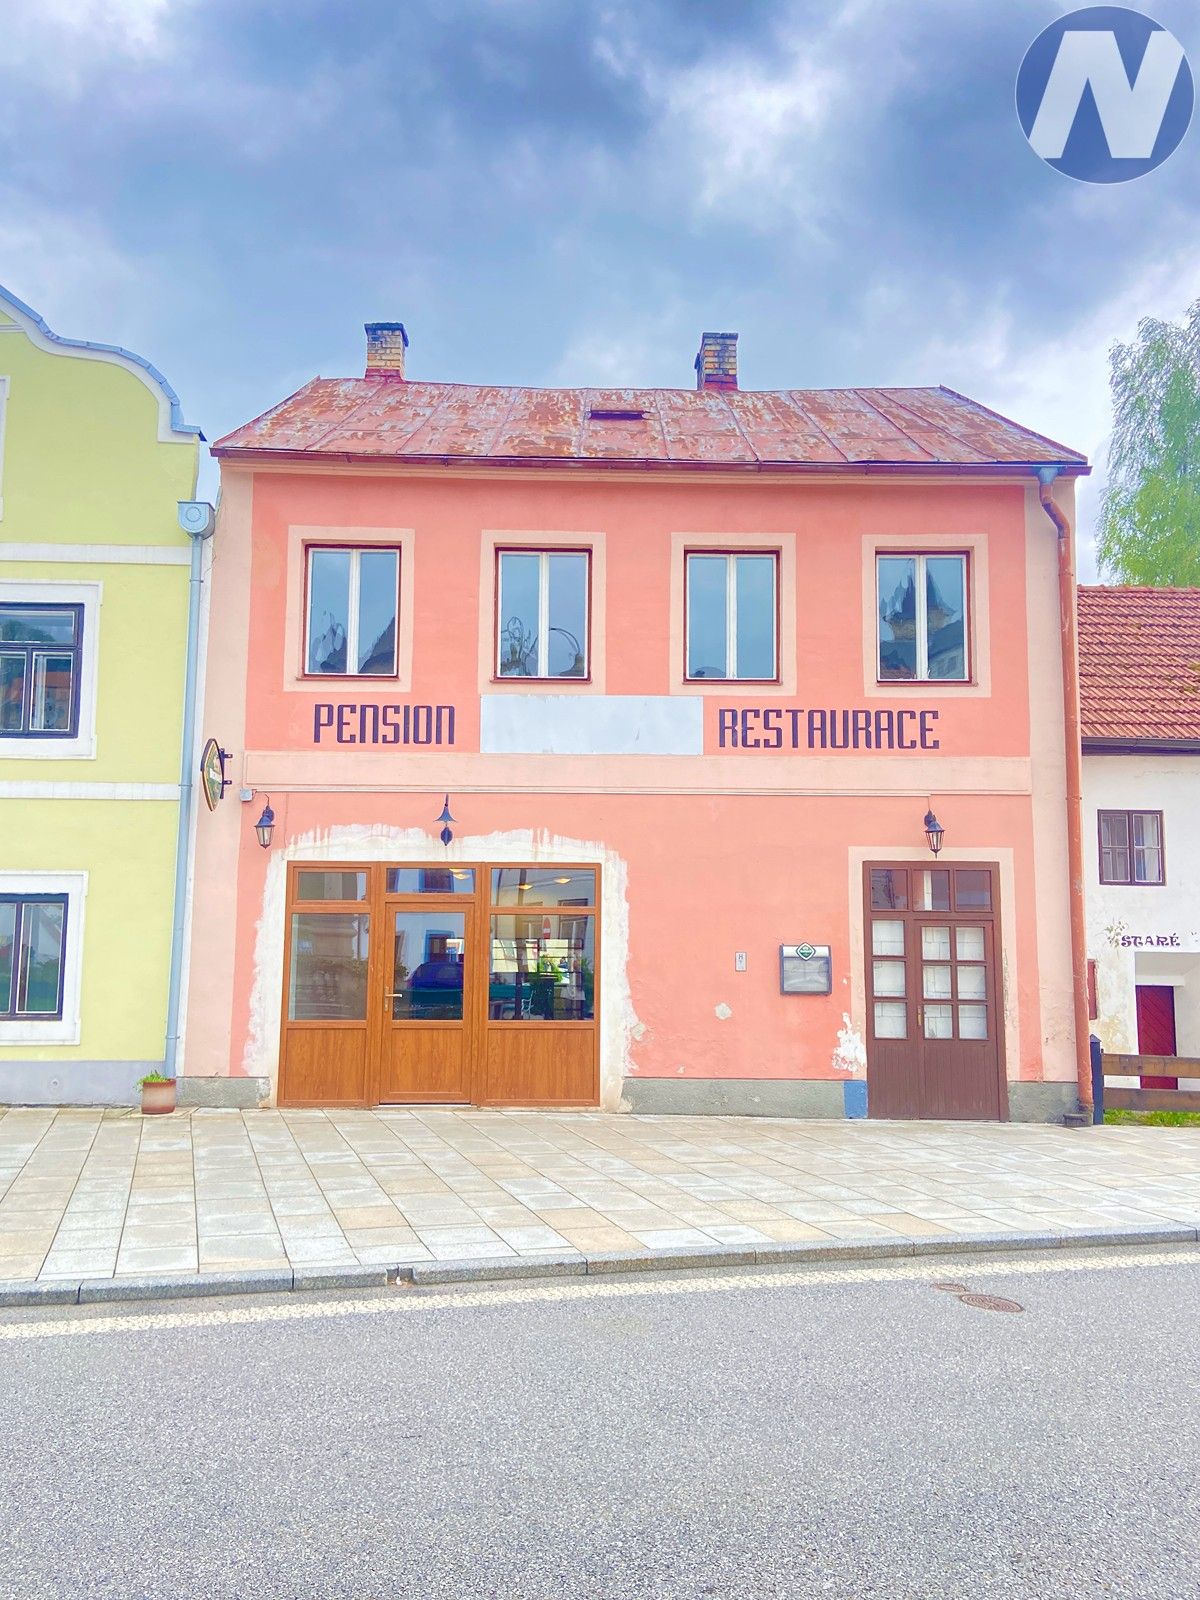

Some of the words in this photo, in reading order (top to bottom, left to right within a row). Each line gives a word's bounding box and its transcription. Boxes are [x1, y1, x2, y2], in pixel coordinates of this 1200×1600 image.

[313, 703, 456, 745] PENSION
[718, 708, 940, 750] RESTAURACE
[1120, 932, 1181, 948] STARÉ
